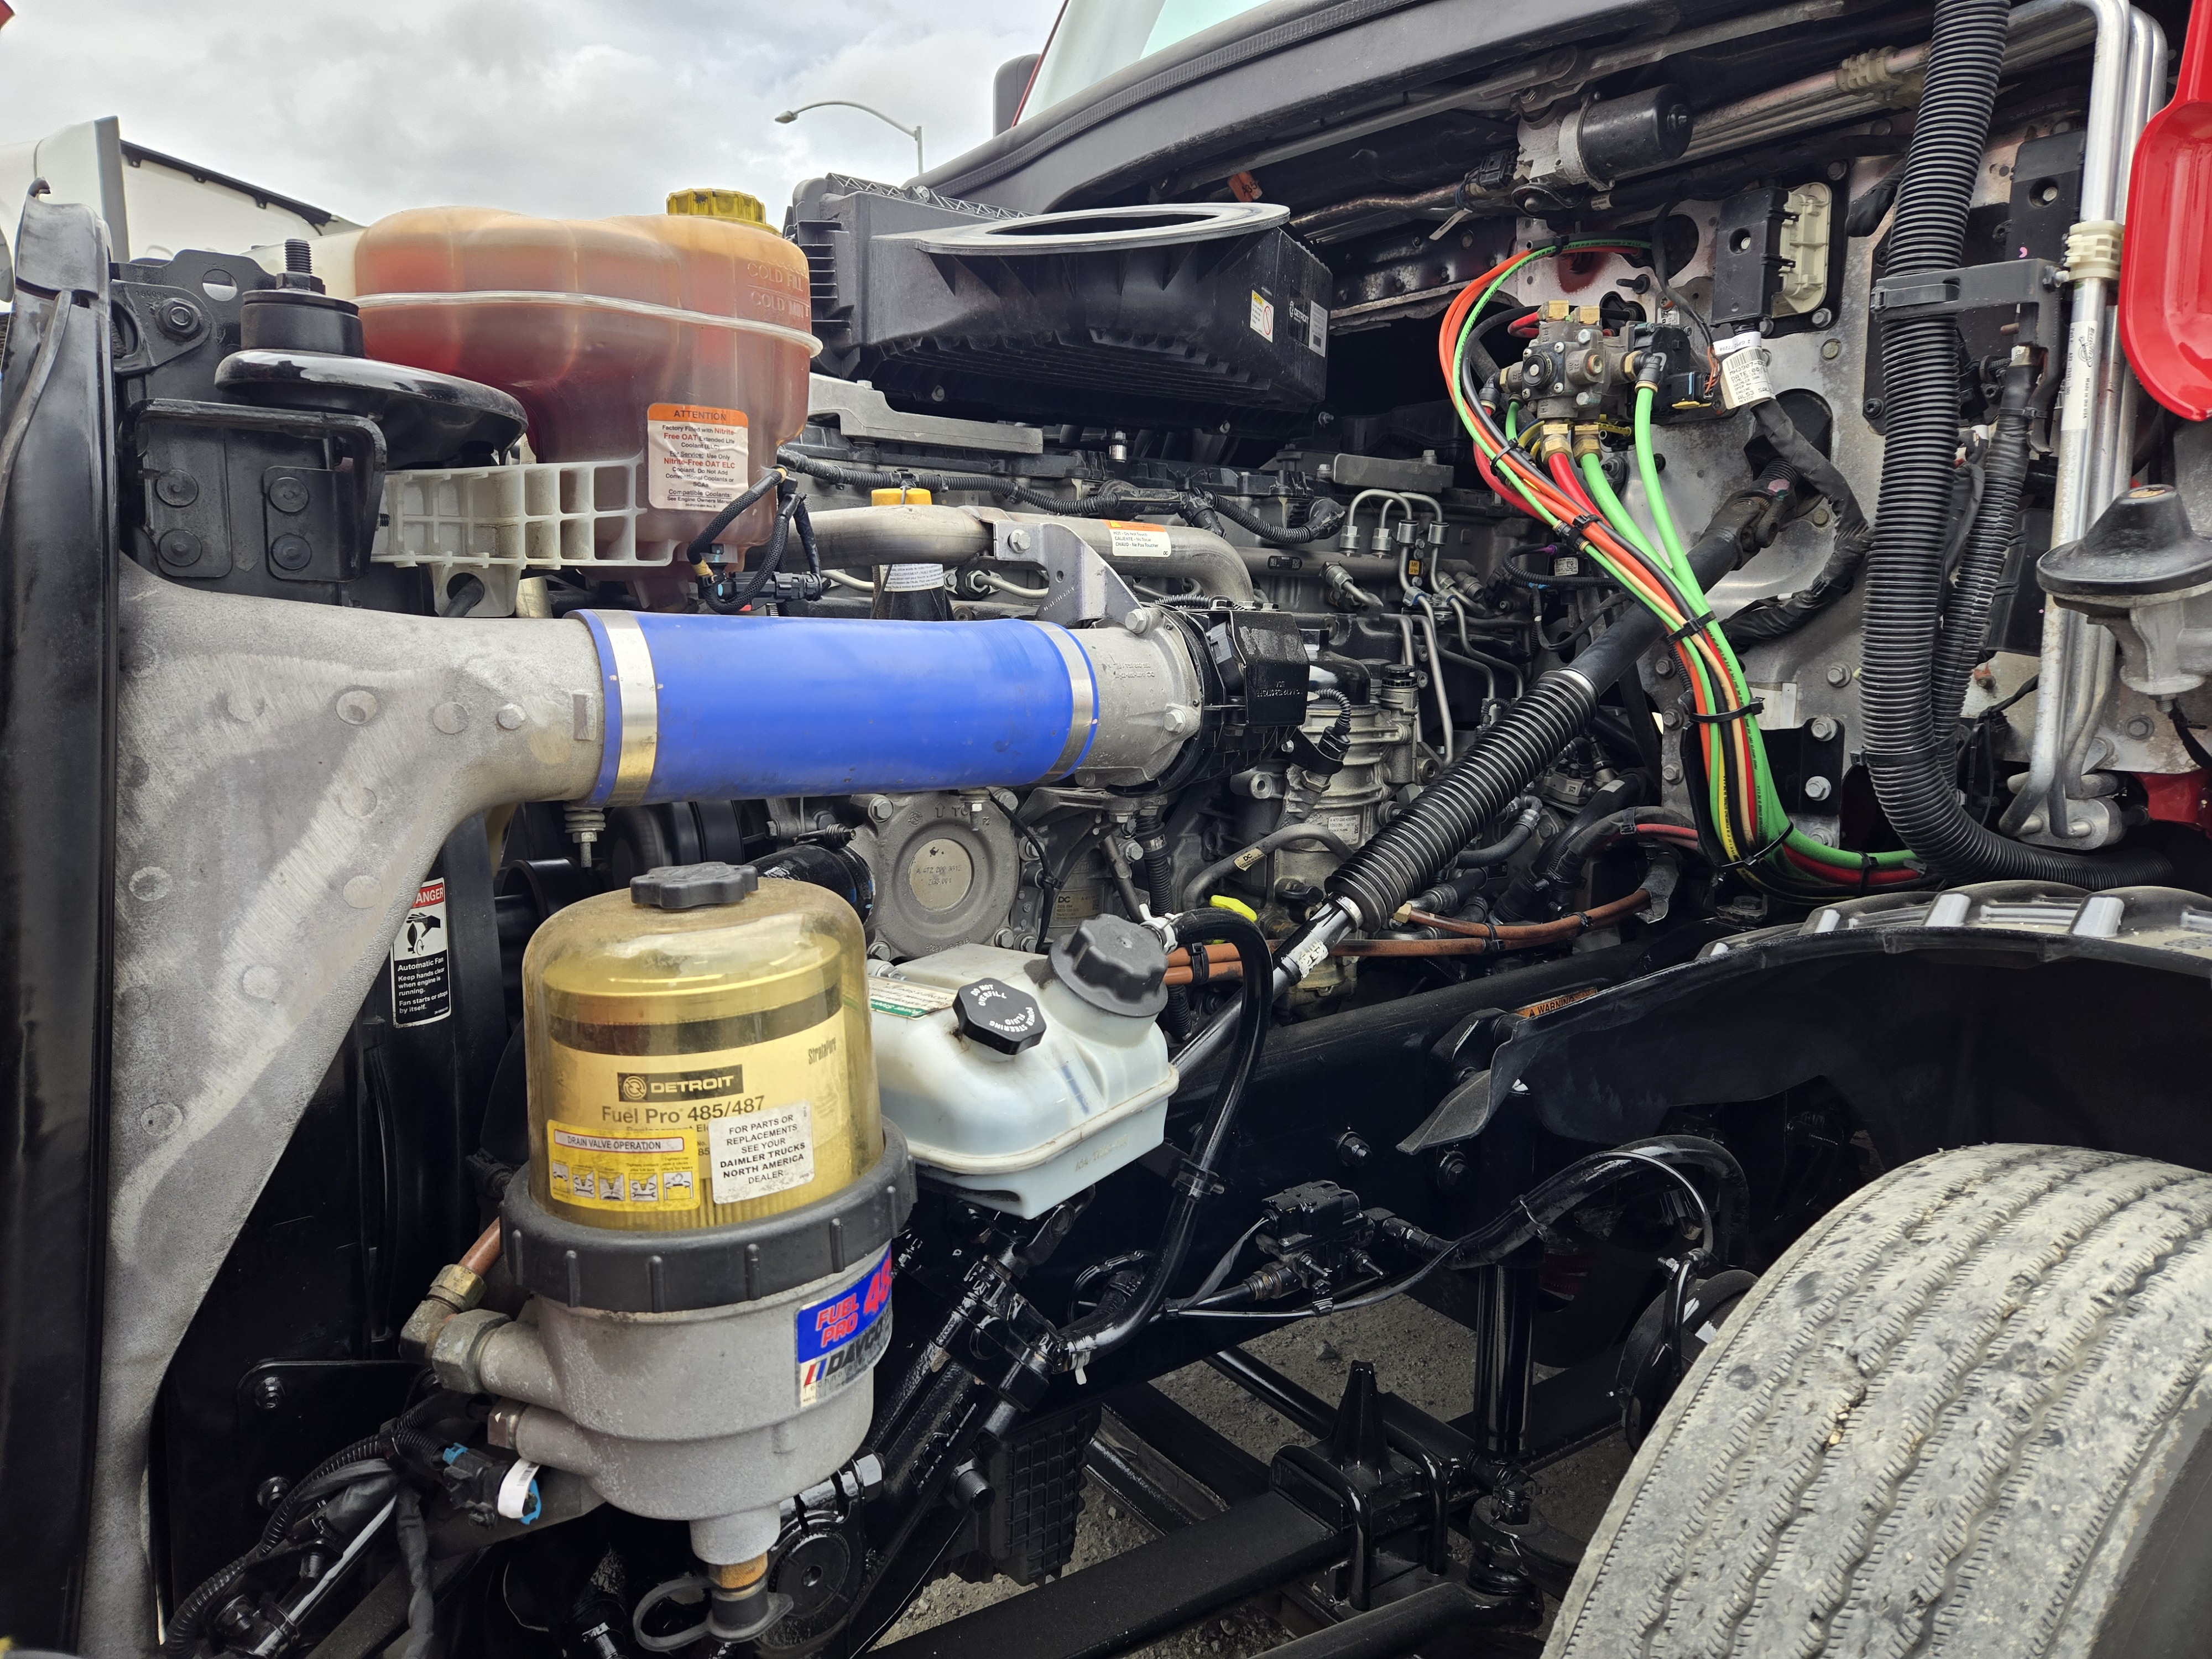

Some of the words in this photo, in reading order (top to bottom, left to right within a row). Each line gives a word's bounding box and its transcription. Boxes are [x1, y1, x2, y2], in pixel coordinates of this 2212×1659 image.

[747, 262, 782, 283] COLD
[787, 273, 803, 292] FILL
[751, 291, 785, 311] COLD
[1294, 307, 1309, 324] DETROIT
[674, 410, 726, 421] ATTENTION
[664, 458, 703, 466] Nitrite-Free
[952, 805, 969, 817] TO
[416, 888, 444, 904] ANGER
[398, 960, 434, 971] Automatic
[971, 988, 980, 996] DO
[978, 990, 1007, 1006] OVERFILL
[409, 1004, 427, 1012] itself.
[1538, 996, 1575, 1014] WARNING
[1004, 1013, 1026, 1025] FLUID
[1025, 1007, 1035, 1026] POWER
[989, 1020, 1028, 1032] STEERING
[650, 1076, 734, 1094] DETROIT
[602, 1106, 639, 1124] Fuel
[646, 1108, 680, 1124] Pro
[687, 1095, 765, 1120] 485/487
[729, 1125, 748, 1135] FOR
[751, 1118, 779, 1131] PARTS
[781, 1114, 794, 1123] OR
[567, 1136, 587, 1147] DRAIN
[588, 1138, 611, 1149] VALVE
[613, 1141, 661, 1150] OPERATION
[727, 1124, 797, 1146] REPLACEMENTS
[742, 1144, 759, 1154] SEE
[761, 1138, 786, 1149] YOUR
[720, 1153, 765, 1168] DAIMLER
[768, 1142, 805, 1158] TRUCKS
[723, 1165, 758, 1178] NORTH
[762, 1153, 804, 1170] AMERICA
[748, 1170, 784, 1184] DEALER
[816, 1292, 859, 1331] FUEL
[863, 1259, 892, 1314] 48
[821, 1312, 858, 1348] PRO
[826, 1316, 884, 1377] DAYCO
